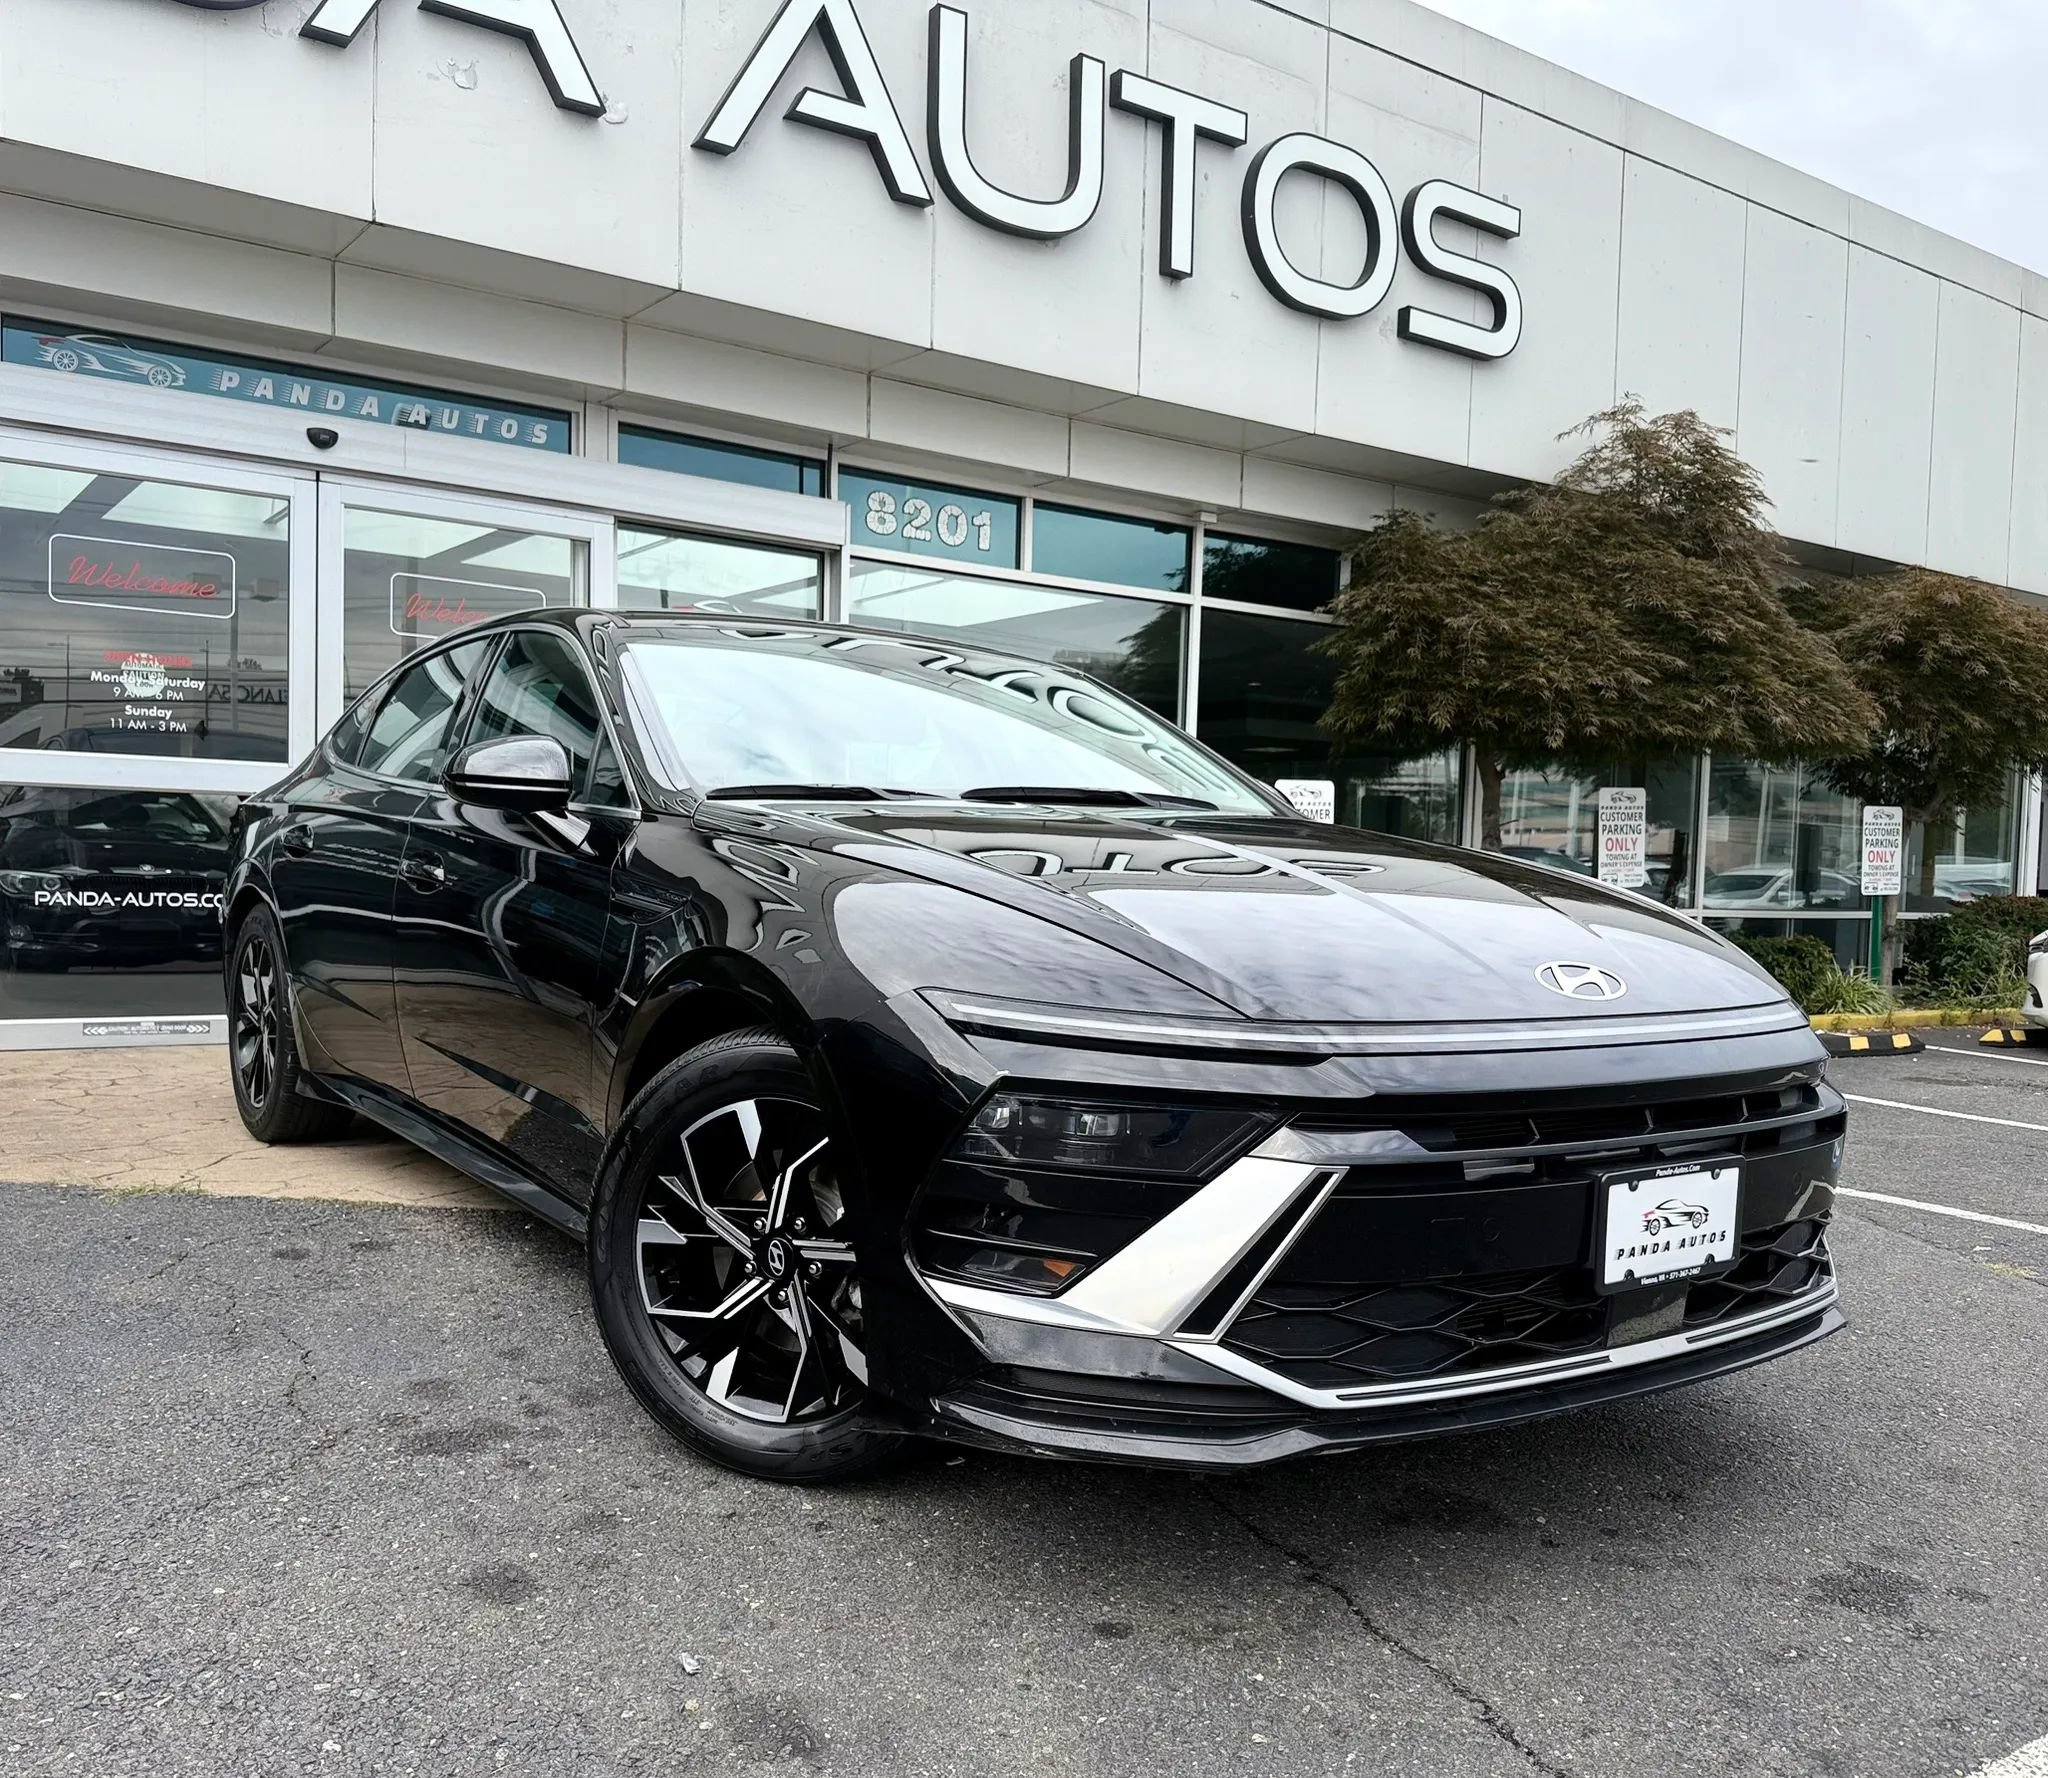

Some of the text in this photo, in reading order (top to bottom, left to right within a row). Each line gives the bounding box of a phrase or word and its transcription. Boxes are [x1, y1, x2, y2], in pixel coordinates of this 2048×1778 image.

[694, 0, 1523, 358] AUTOS
[212, 368, 548, 445] PANDA AUTOS
[865, 491, 991, 550] 8201
[67, 555, 219, 599] Welcome
[113, 687, 121, 698] 9
[155, 689, 163, 700] 6
[166, 690, 184, 701] PM
[124, 704, 173, 720] Sunday
[110, 718, 123, 729] 11
[127, 719, 147, 730] AM
[158, 720, 166, 731] 3
[169, 721, 187, 733] PM
[1296, 808, 1331, 820] OMER
[1600, 811, 1643, 822] CUSTOMER
[1602, 823, 1642, 836] PARKING
[1864, 827, 1900, 837] CUSTOMER
[1605, 837, 1638, 852] ONLY
[1865, 838, 1899, 848] PARKING
[1606, 853, 1629, 861] TOWING
[1868, 850, 1896, 863] ONLY
[35, 890, 223, 908] PANDA-AUTOS.CO
[1615, 1230, 1727, 1260] PANDA AUTOS
